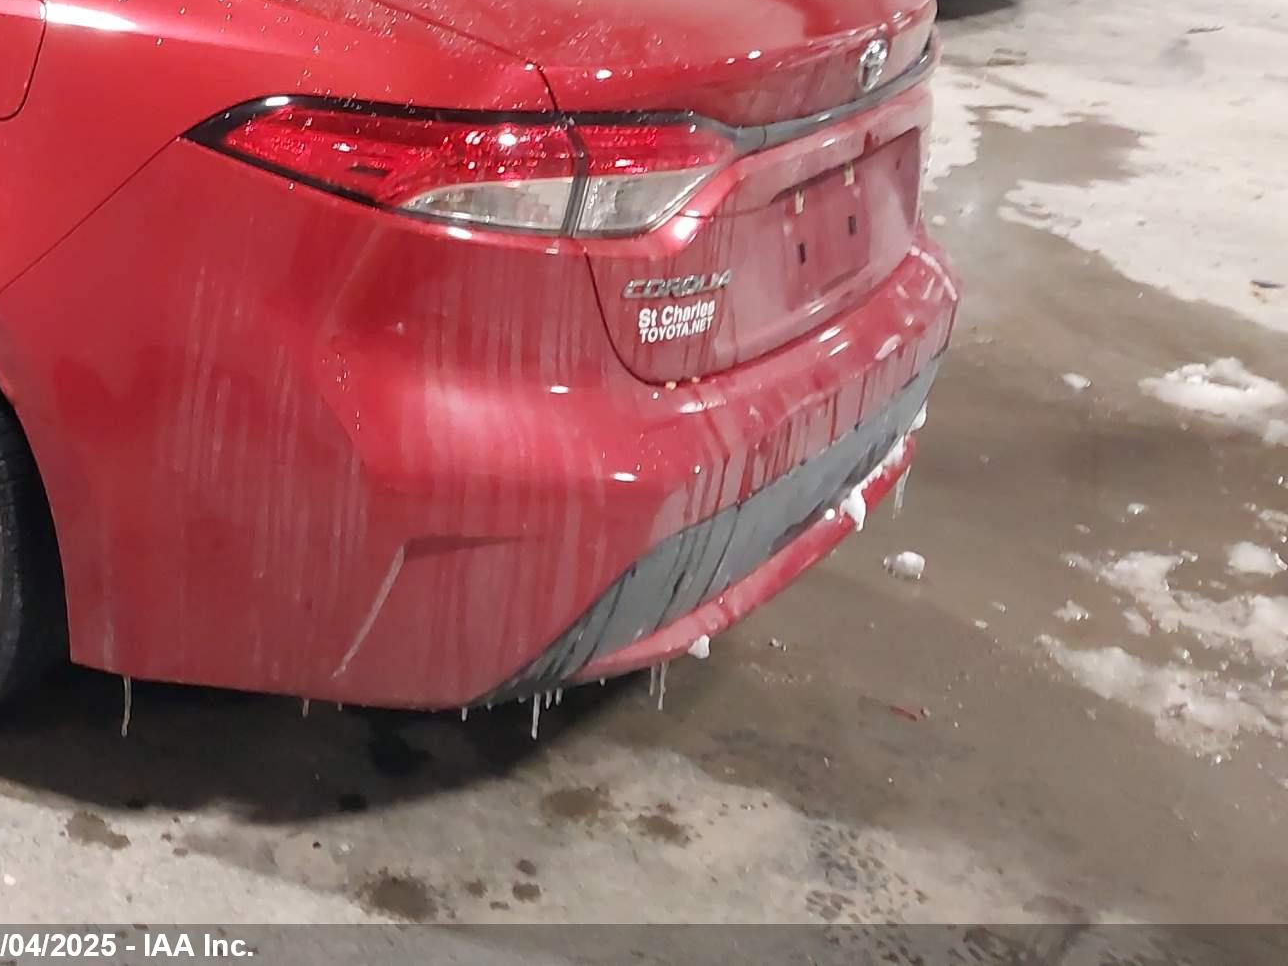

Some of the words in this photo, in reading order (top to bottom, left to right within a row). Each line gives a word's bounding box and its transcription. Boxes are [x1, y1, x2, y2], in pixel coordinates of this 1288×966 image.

[638, 307, 658, 329] St
[661, 299, 716, 326] Charles
[639, 315, 714, 344] TOYOTA.NET
